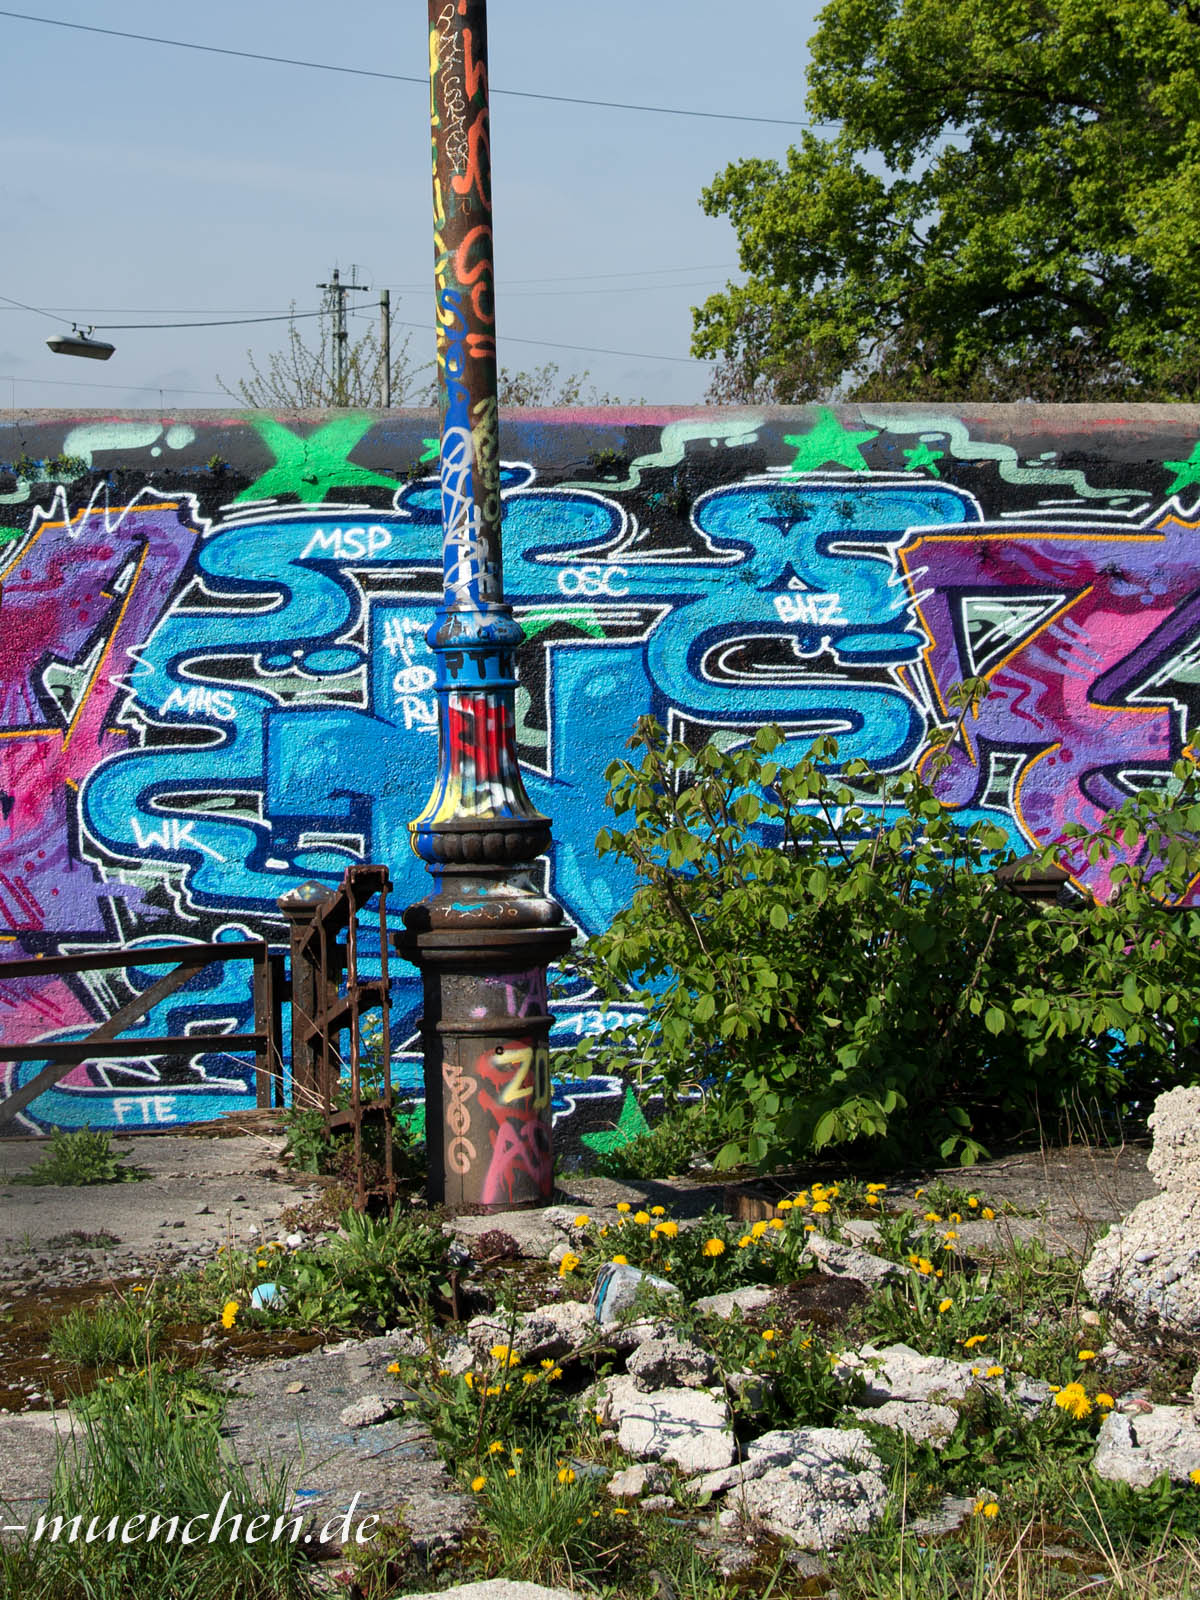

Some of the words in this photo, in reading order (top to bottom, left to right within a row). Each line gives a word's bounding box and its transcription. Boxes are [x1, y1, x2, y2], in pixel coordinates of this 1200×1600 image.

[300, 526, 392, 559] MSP
[130, 817, 228, 863] WK
[113, 1094, 177, 1124] FTE
